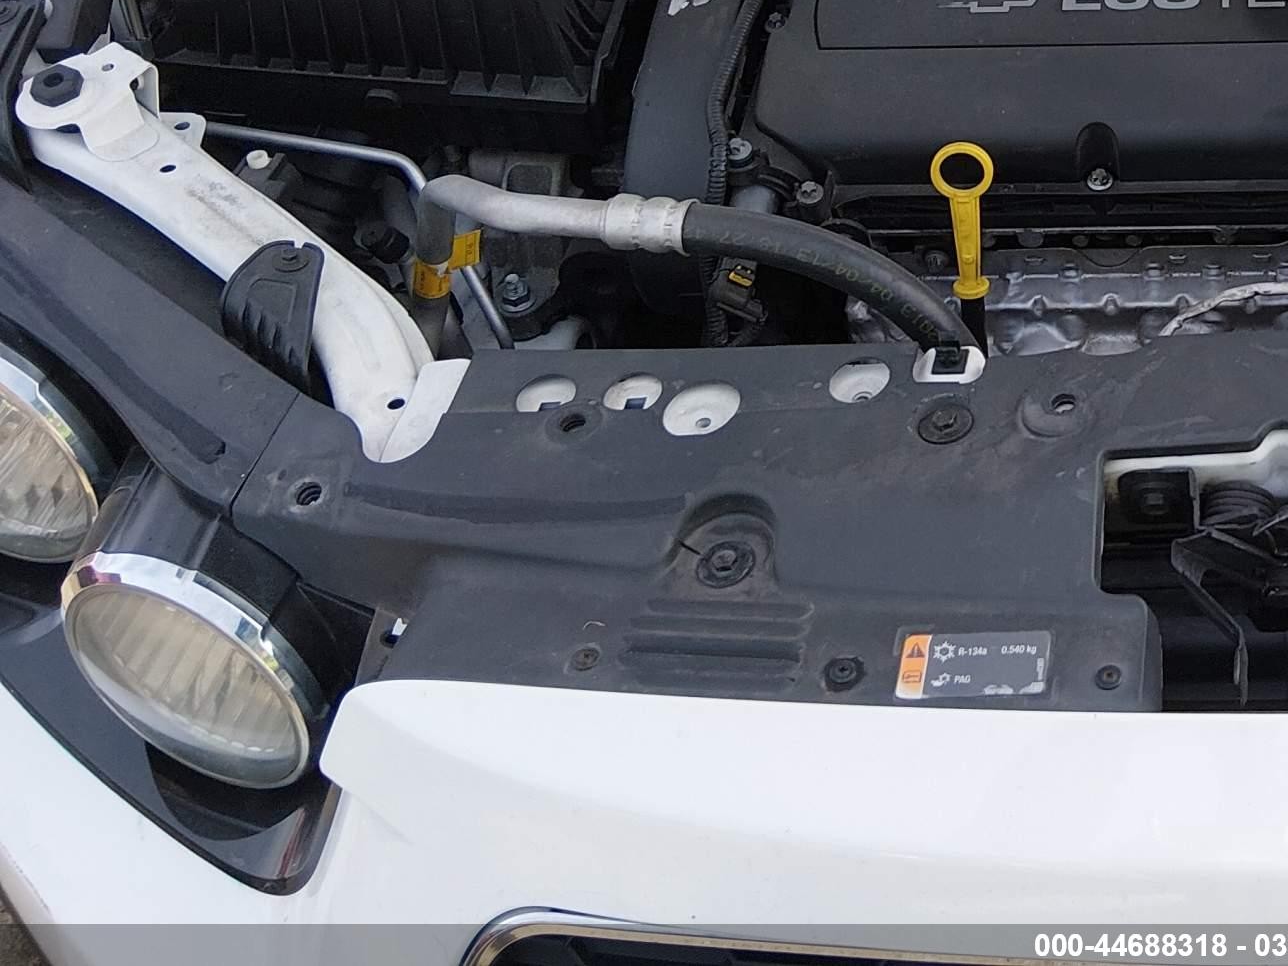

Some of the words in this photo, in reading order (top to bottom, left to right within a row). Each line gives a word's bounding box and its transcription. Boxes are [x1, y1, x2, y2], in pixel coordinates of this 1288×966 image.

[958, 645, 988, 657] R-134a
[1001, 644, 1025, 655] 0.540
[1026, 644, 1038, 656] kg
